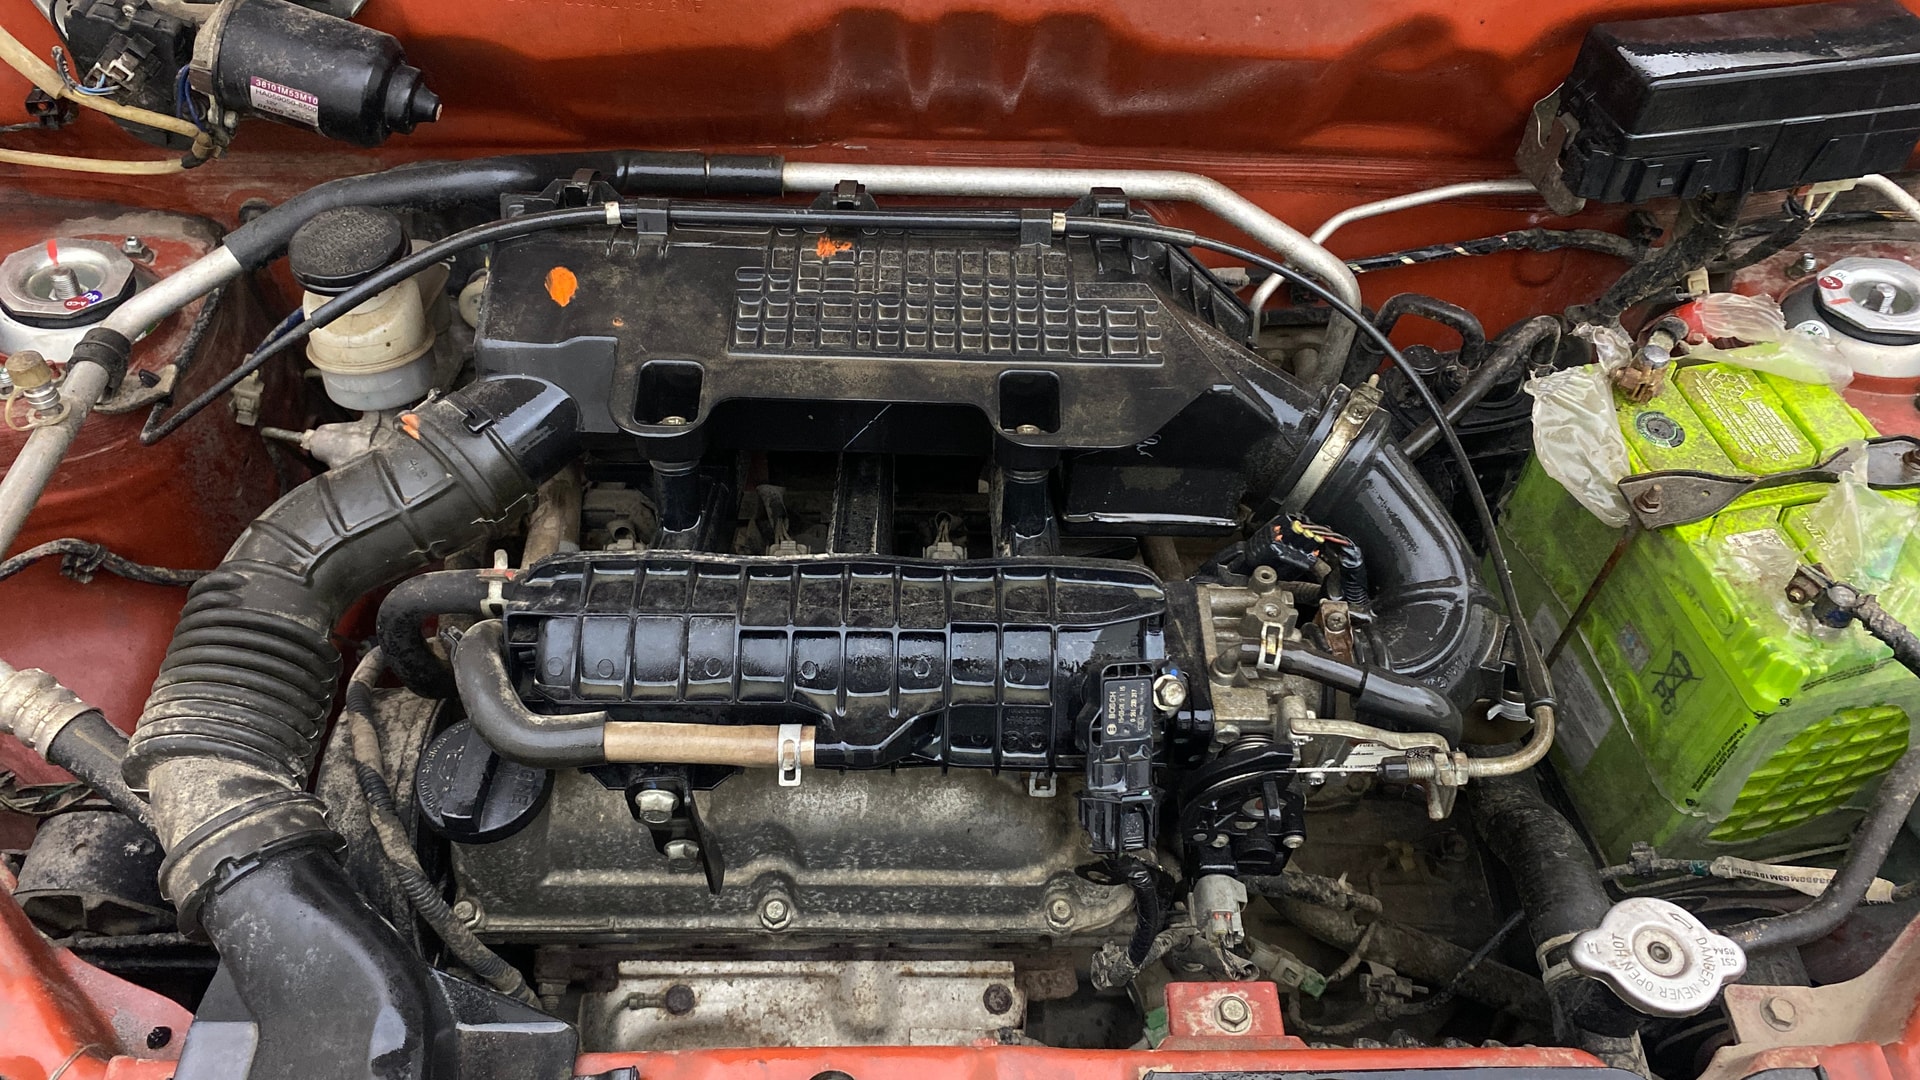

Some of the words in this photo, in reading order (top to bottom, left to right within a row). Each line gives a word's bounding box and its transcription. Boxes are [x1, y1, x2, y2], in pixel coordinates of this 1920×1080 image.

[255, 79, 319, 105] 38101M53M10
[1108, 691, 1117, 719] BOSCH
[1612, 932, 1630, 958] HOT
[1620, 960, 1654, 992] OPEN
[1659, 985, 1701, 1000] NEVER
